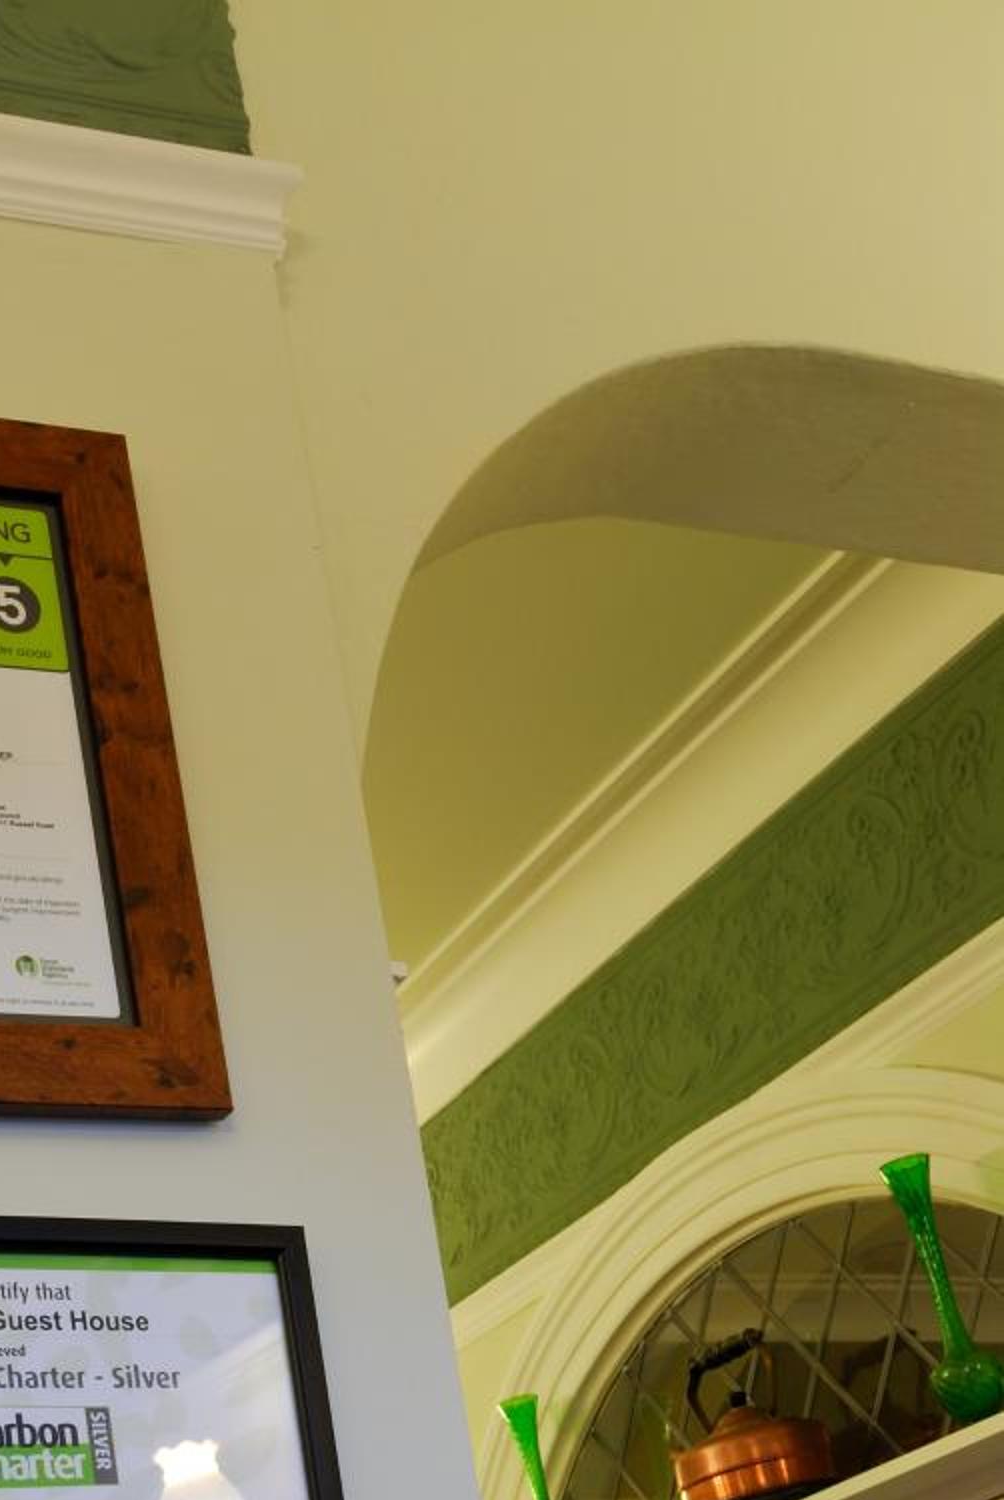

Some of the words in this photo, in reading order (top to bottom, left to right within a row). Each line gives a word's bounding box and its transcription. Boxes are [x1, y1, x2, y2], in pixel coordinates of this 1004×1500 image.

[35, 1283, 72, 1301] that
[70, 1311, 150, 1332] House
[112, 1366, 180, 1390] Silver
[89, 1411, 112, 1471] SILVER
